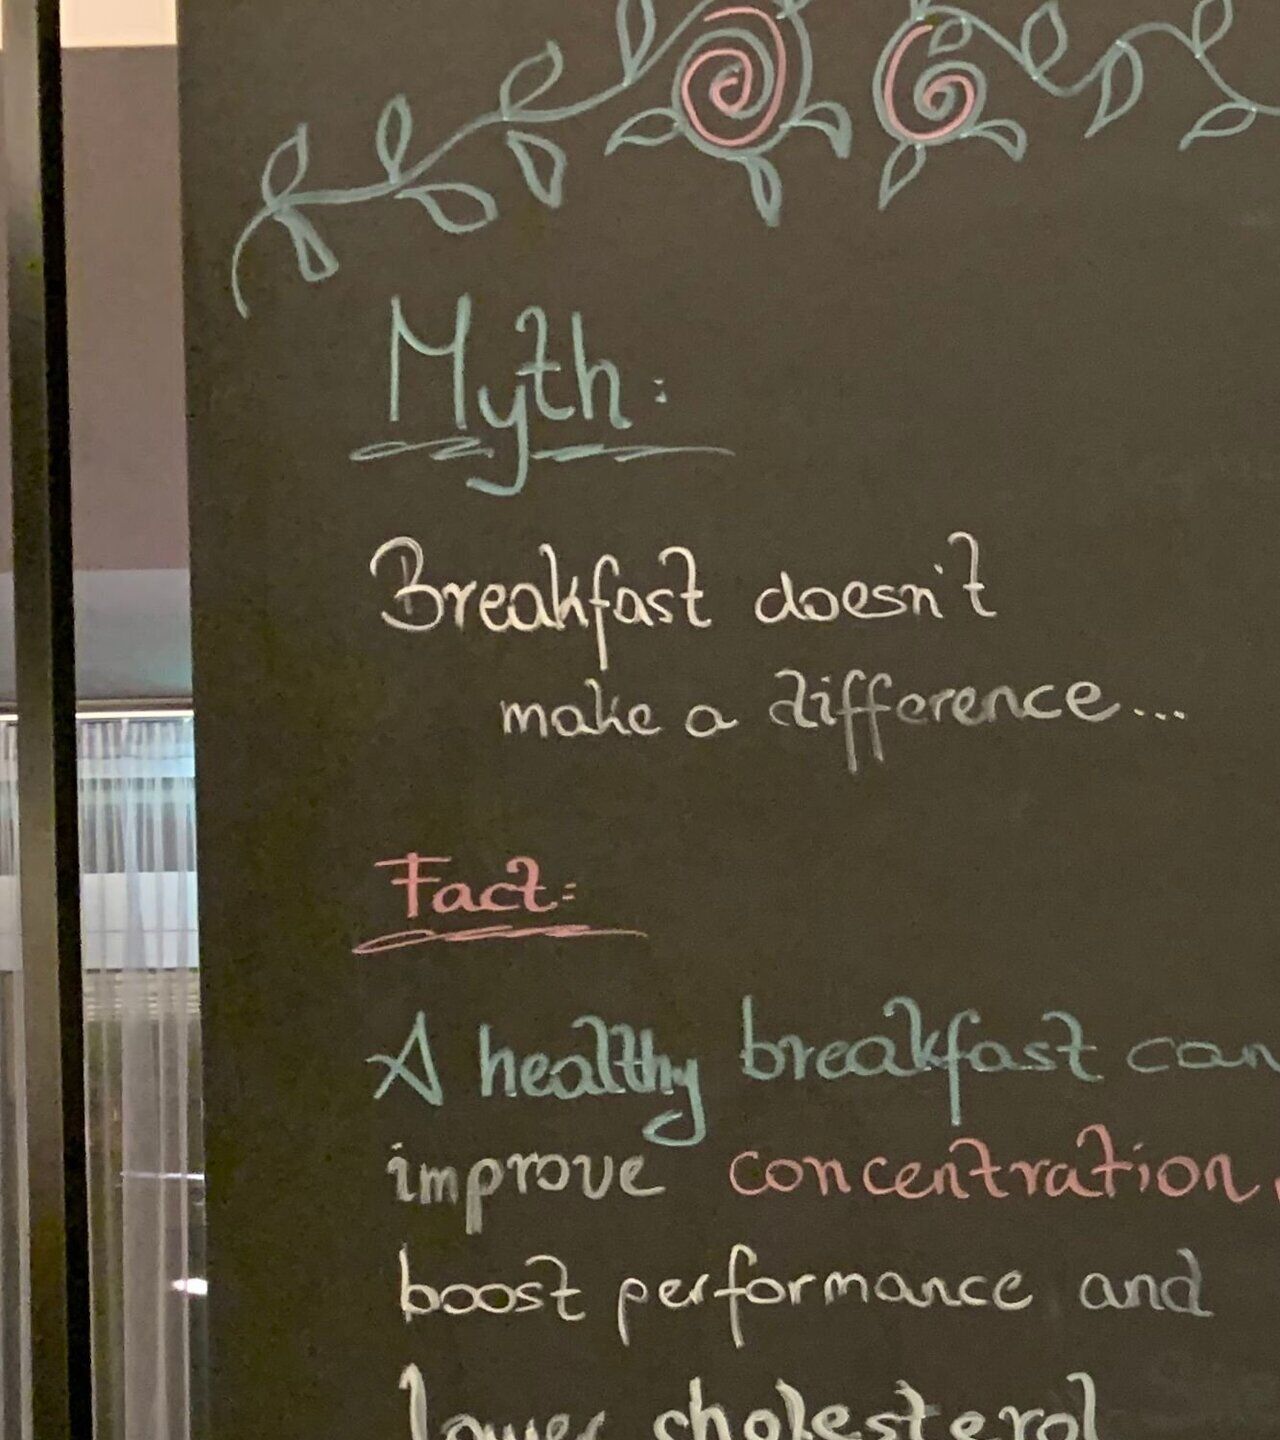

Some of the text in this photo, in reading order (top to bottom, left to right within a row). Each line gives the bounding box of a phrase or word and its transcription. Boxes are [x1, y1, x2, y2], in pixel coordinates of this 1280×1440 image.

[390, 293, 667, 495] Myth:
[369, 531, 997, 670] Breakfast doesn't
[500, 669, 1187, 774] make a difference...
[374, 851, 577, 918] Fact:
[365, 1010, 443, 1107] A
[479, 1014, 707, 1147] healthy
[742, 995, 1104, 1126] breakfast
[387, 1143, 666, 1234] improve
[399, 1242, 1214, 1348] boost performance and
